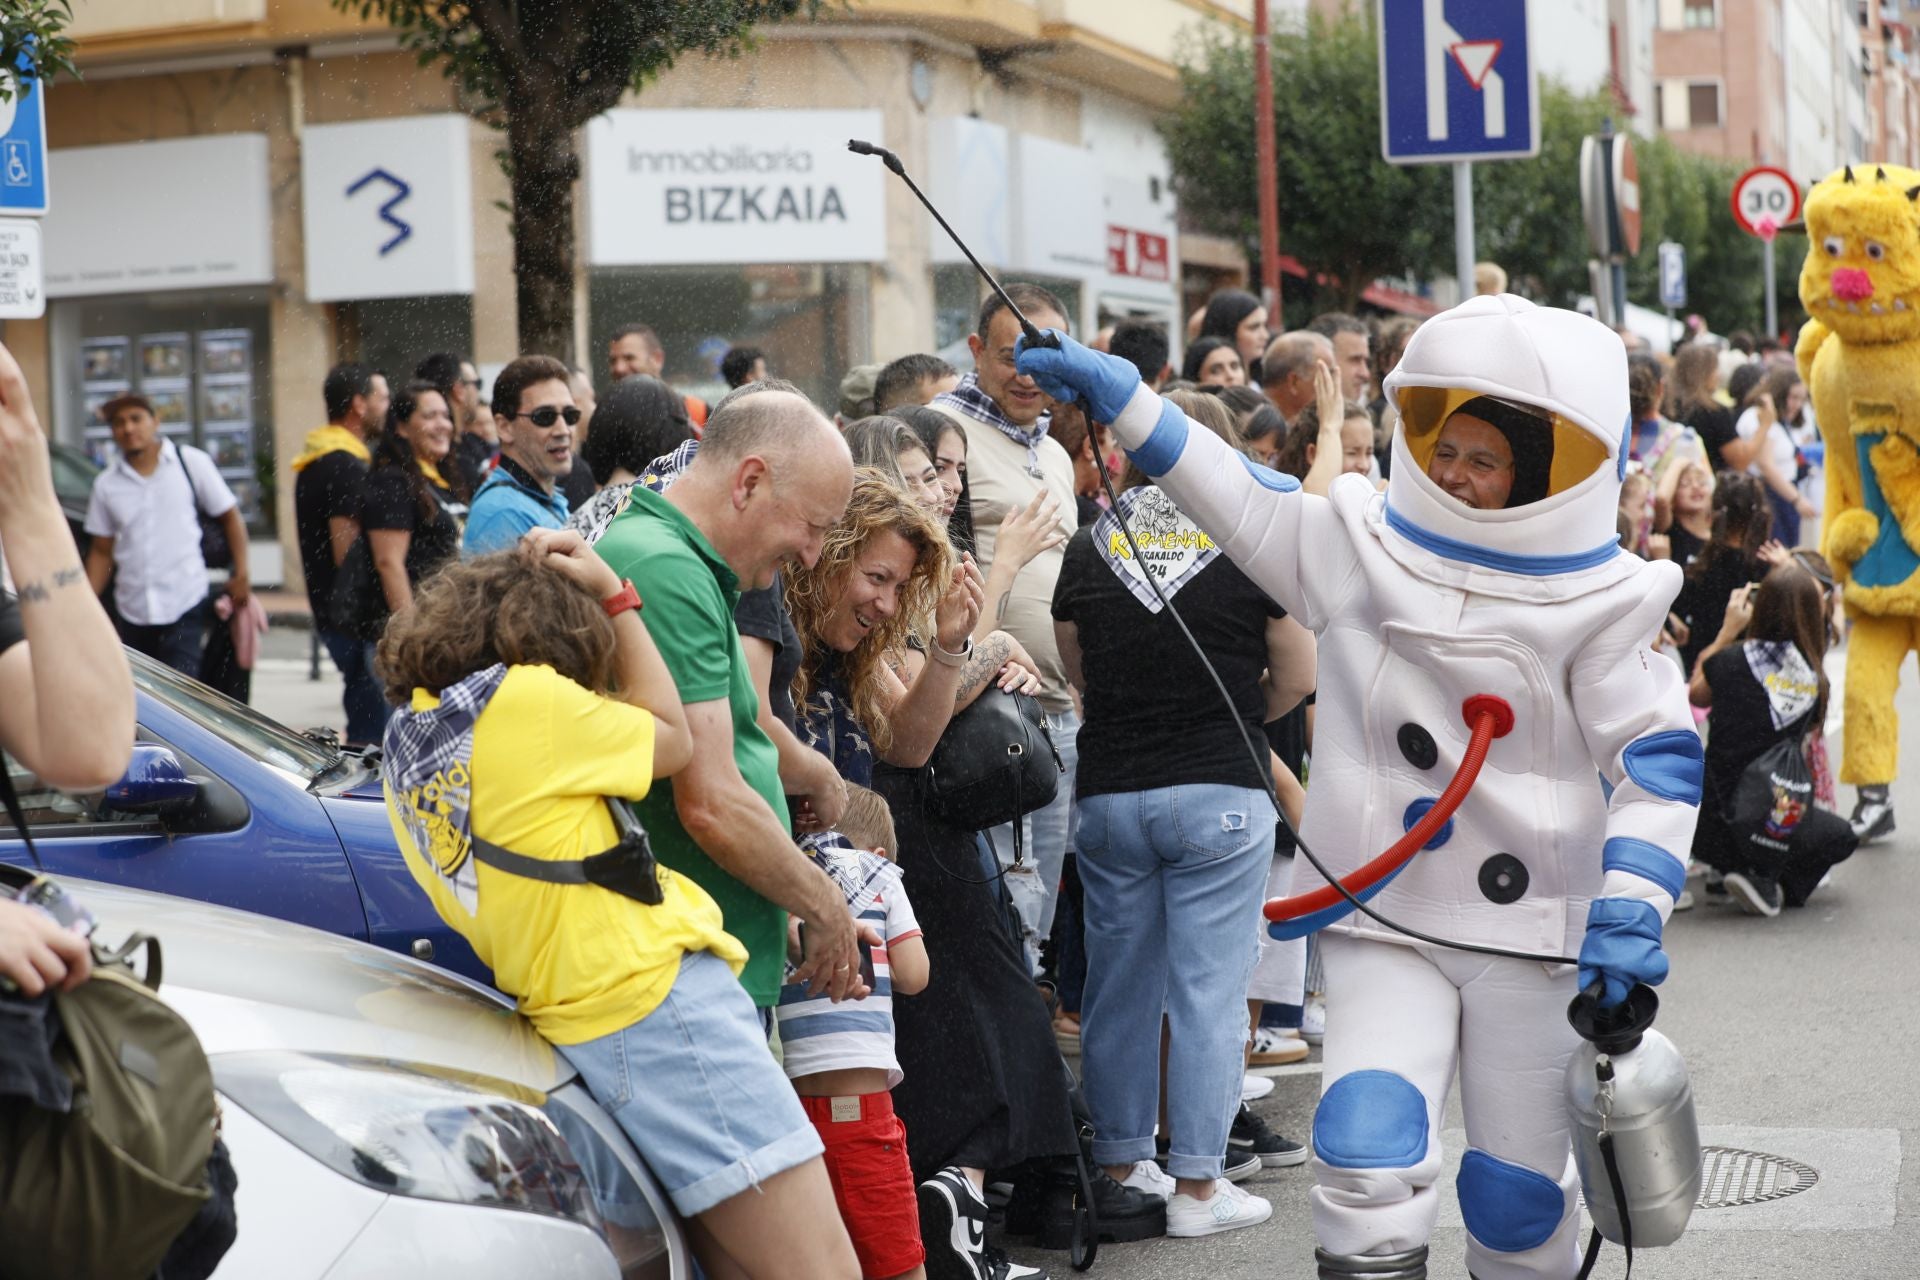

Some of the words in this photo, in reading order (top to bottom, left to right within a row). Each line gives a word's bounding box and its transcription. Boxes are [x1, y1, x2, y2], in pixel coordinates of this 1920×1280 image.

[628, 146, 813, 173] Inmobiliaria
[665, 186, 847, 223] BIZKAIA
[1748, 189, 1786, 213] 30
